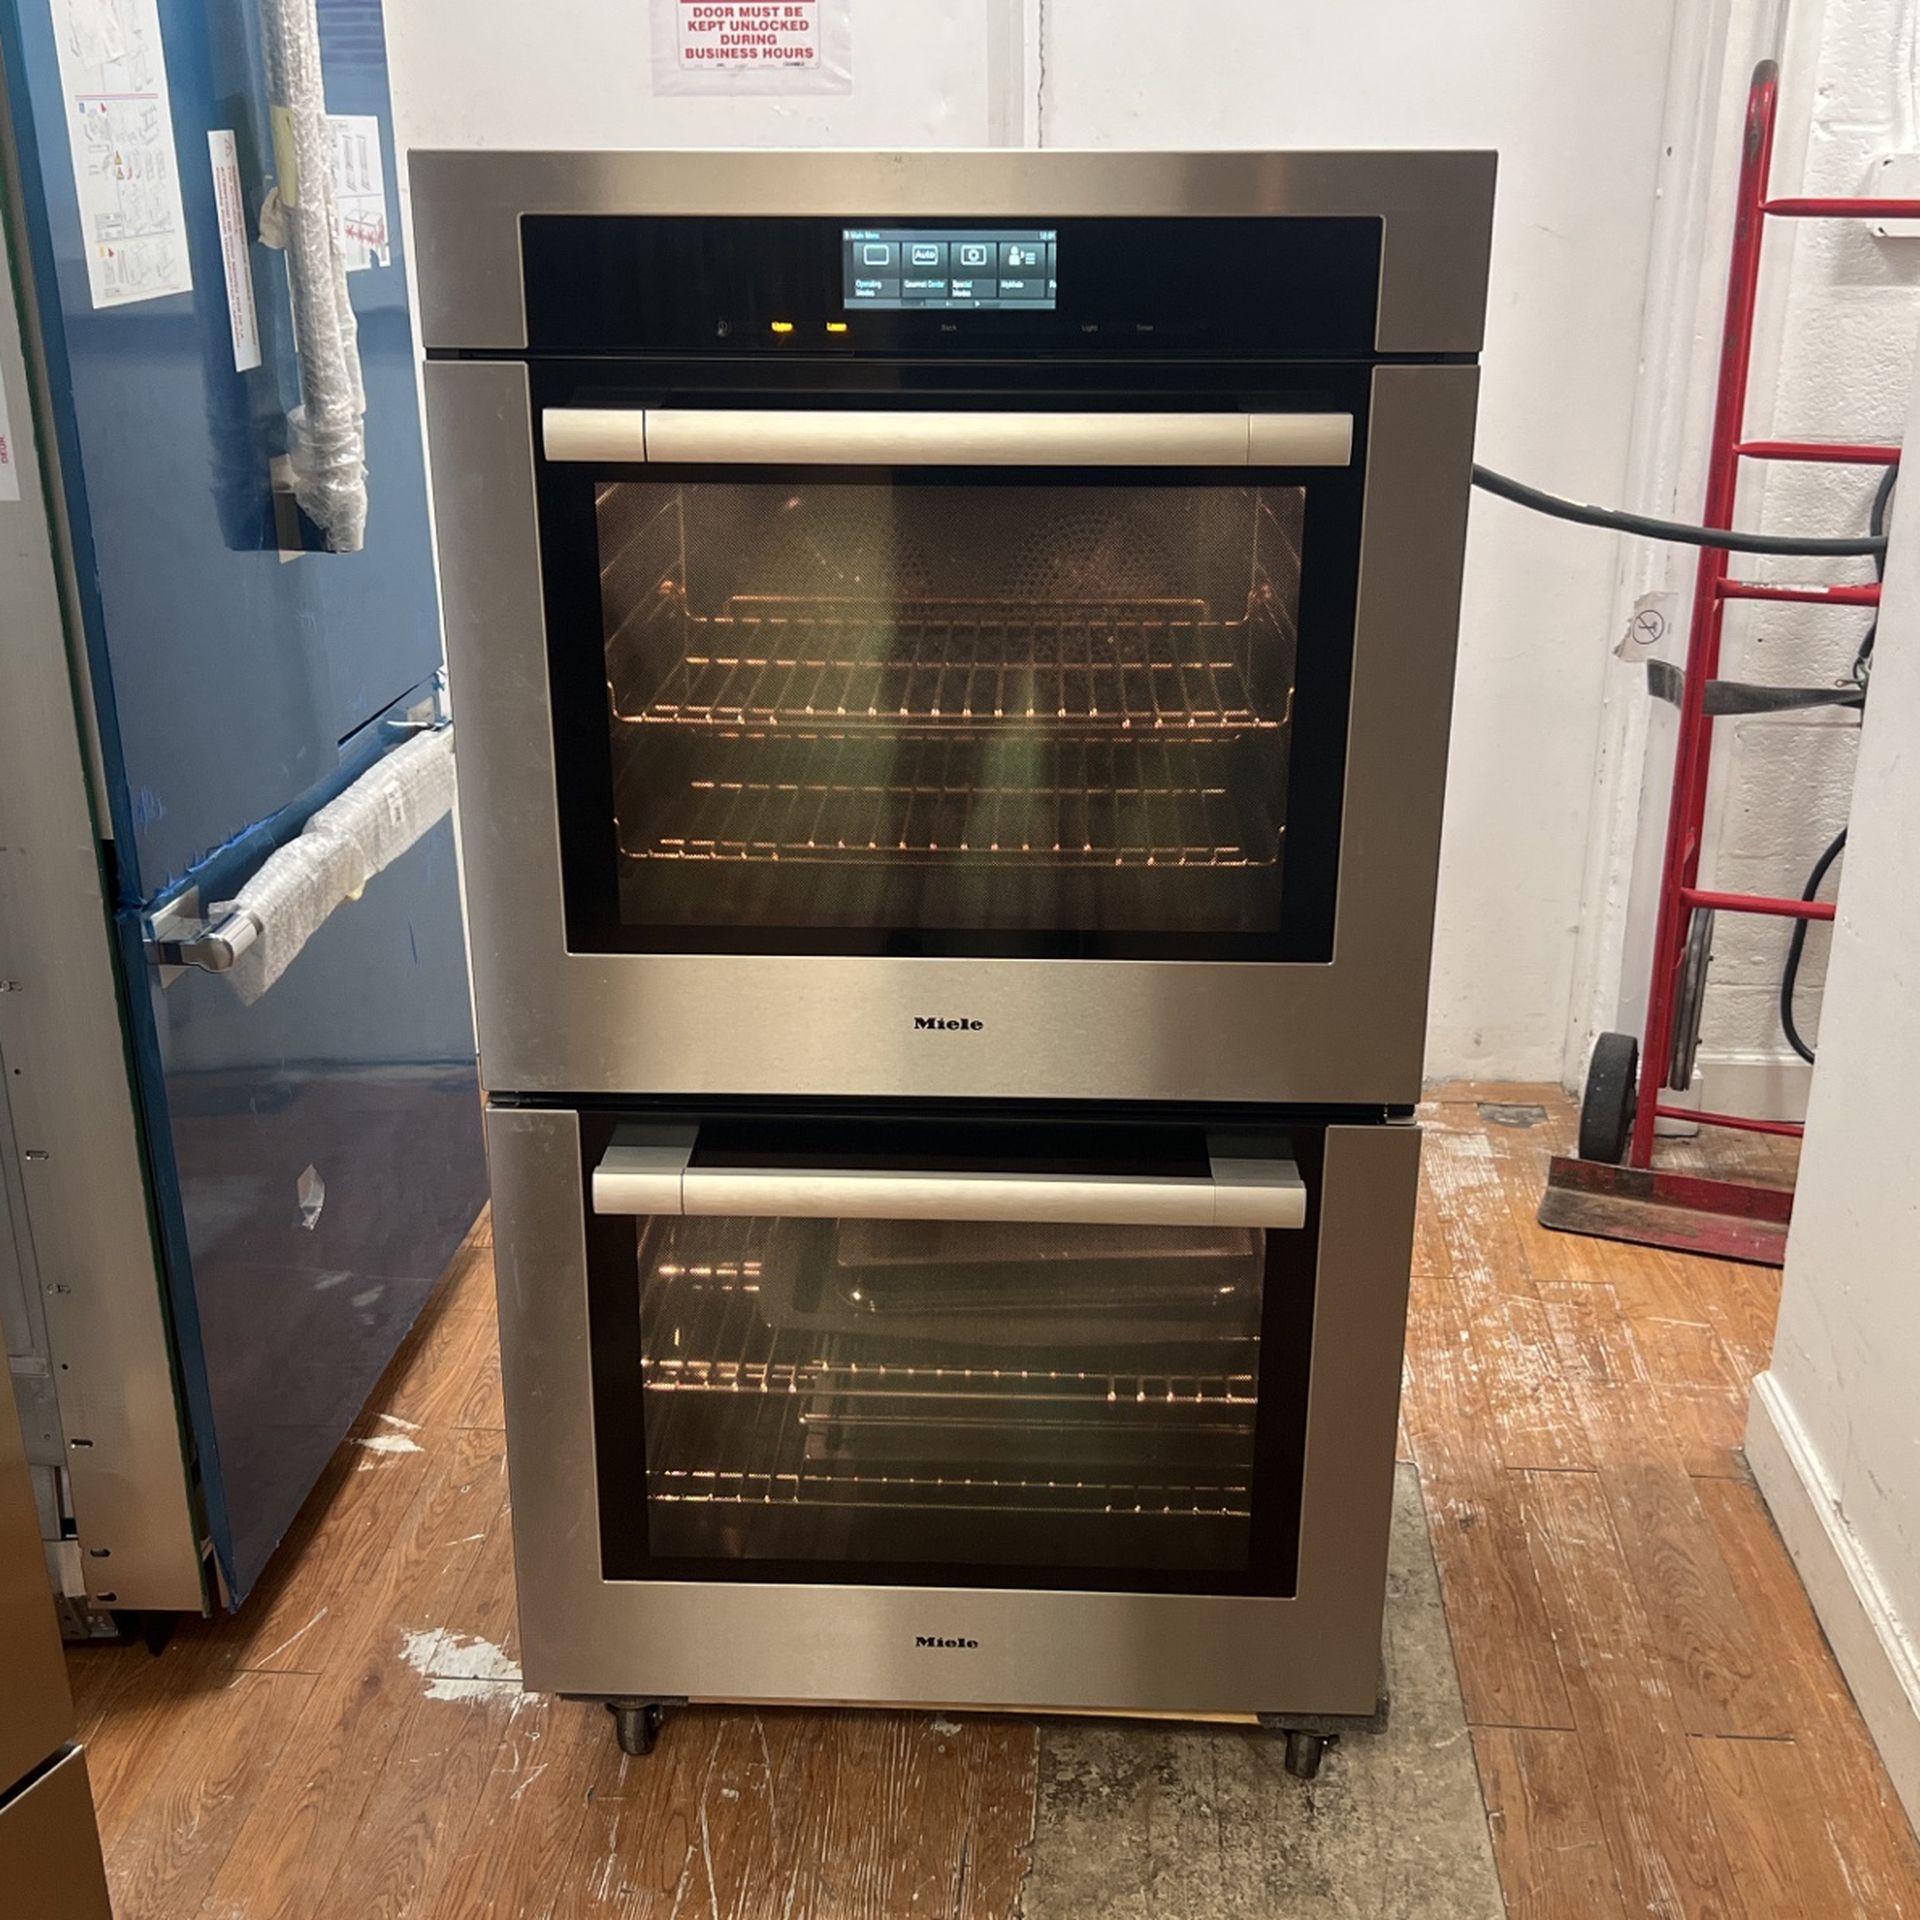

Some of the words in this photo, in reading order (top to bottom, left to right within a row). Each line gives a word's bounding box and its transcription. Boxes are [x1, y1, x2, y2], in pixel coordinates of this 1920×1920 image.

[693, 7, 734, 18] DOOR
[739, 7, 780, 18] MUST
[784, 7, 803, 17] BE
[688, 20, 726, 32] KEPT
[730, 20, 810, 32] UNLOCKED
[720, 34, 777, 45] DURING
[685, 48, 758, 59] BUSINESS
[762, 48, 814, 59] HOURS
[914, 250, 937, 260] Auto
[914, 1017, 984, 1031] Miele
[916, 1637, 979, 1649] Miele
